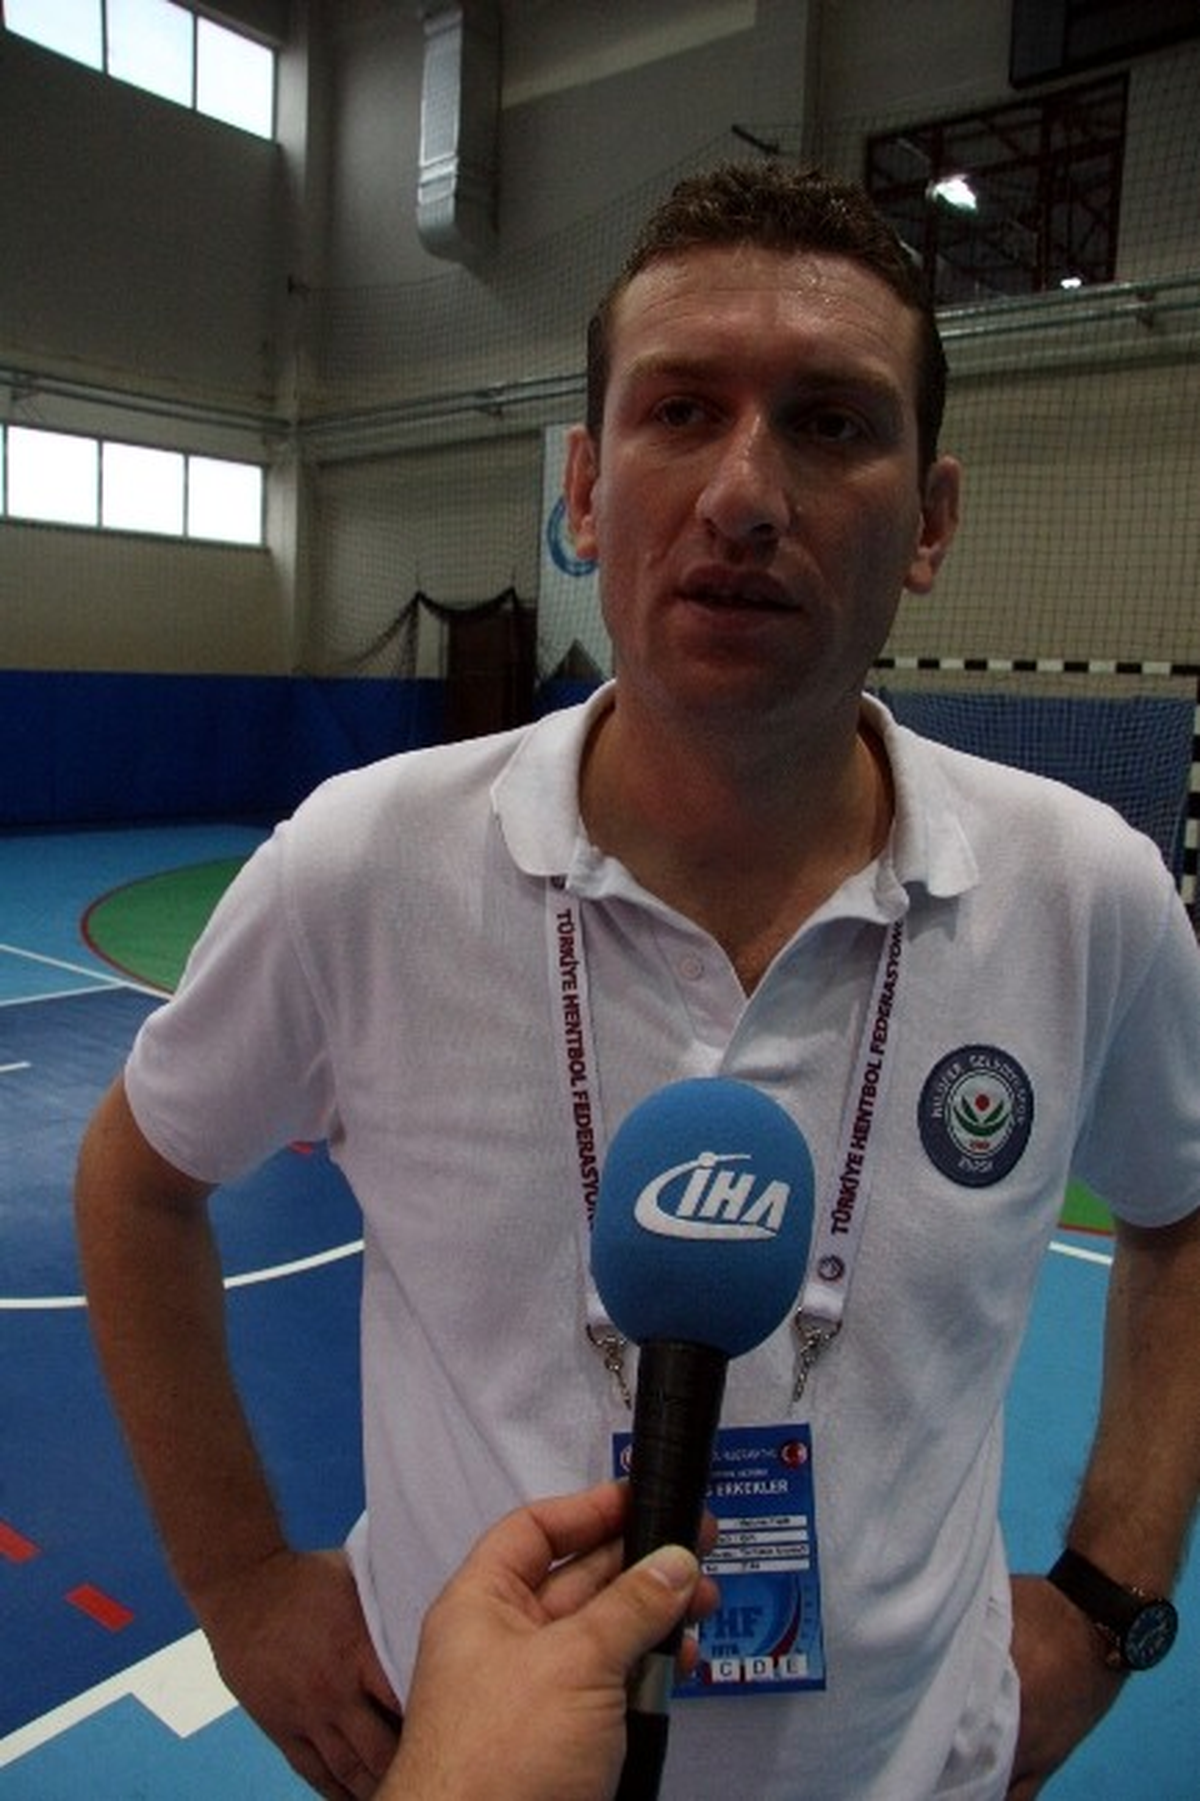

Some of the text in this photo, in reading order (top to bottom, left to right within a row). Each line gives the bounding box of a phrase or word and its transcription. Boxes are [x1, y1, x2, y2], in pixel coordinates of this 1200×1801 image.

[556, 908, 580, 992] TÜRKİYE
[562, 994, 587, 1087] HENTBOL
[831, 1152, 864, 1235] TÜRKİYE
[850, 1058, 883, 1150] HENTBOL
